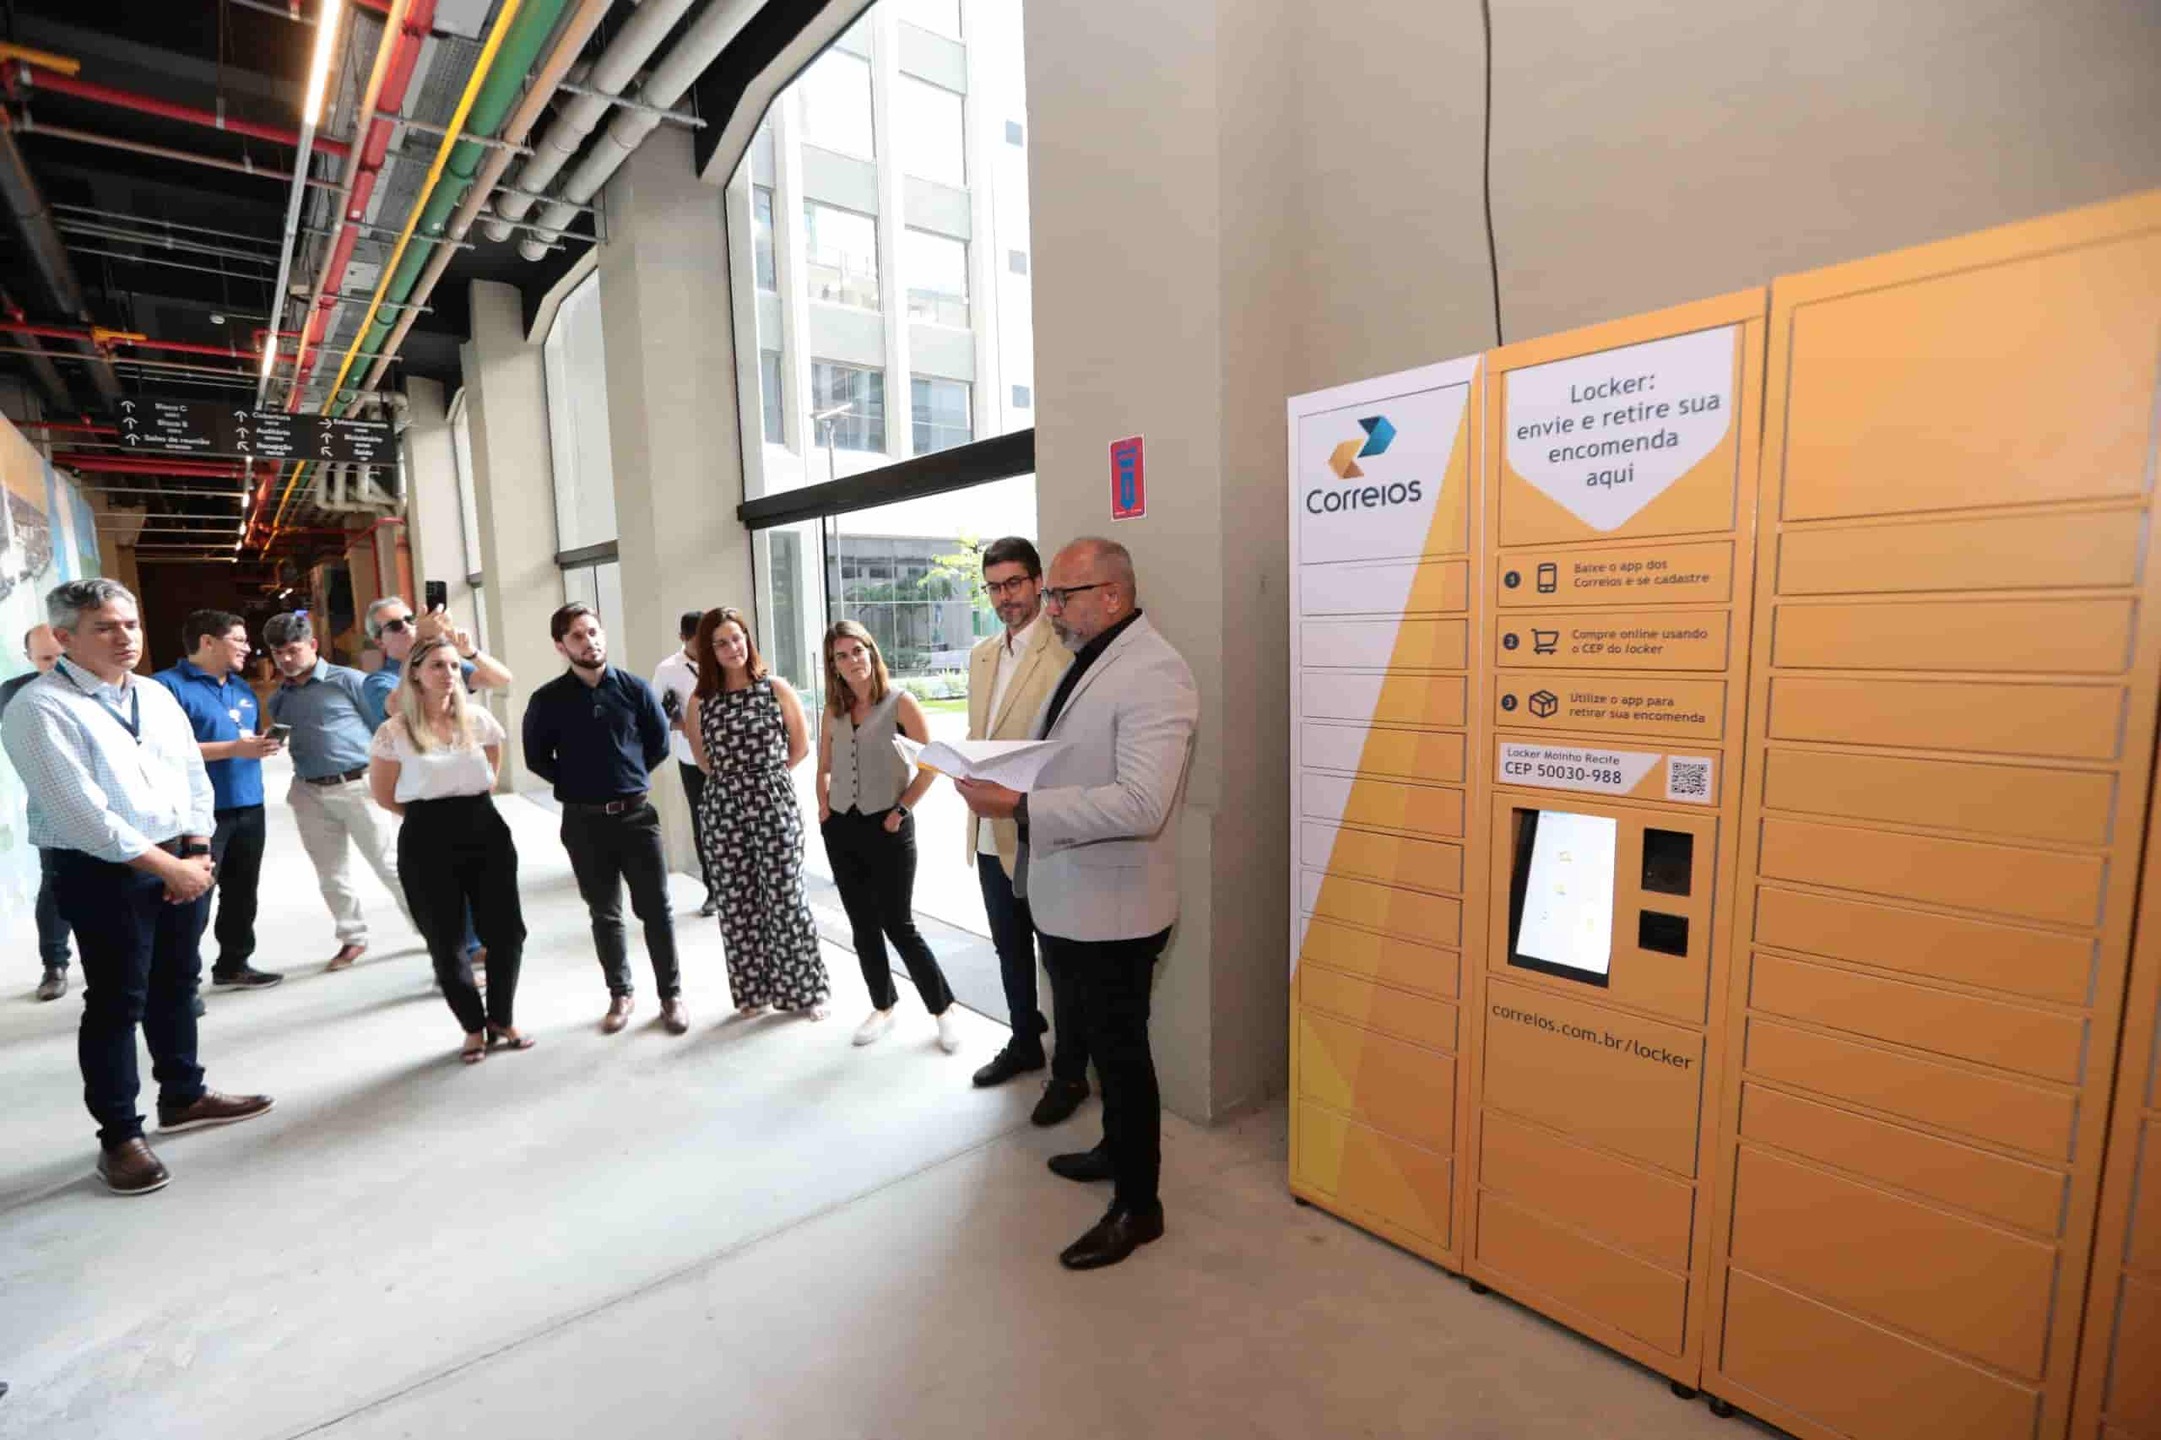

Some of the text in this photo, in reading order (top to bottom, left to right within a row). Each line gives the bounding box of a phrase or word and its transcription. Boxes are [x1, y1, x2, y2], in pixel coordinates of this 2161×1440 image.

[1571, 373, 1656, 404] Locker:
[1517, 392, 1720, 440] envie e retire sua
[1548, 429, 1678, 463] encomenda
[1586, 463, 1634, 489] aqui
[1306, 479, 1422, 514] Correios
[1574, 559, 1668, 574] Baixe o app dos
[1574, 573, 1710, 588] Correios e se cadastre
[1572, 628, 1708, 640] Compre online usando
[1571, 643, 1664, 655] o CEP do locker
[1570, 693, 1674, 709] Utilize o app para
[1569, 708, 1706, 724] retirar sua encomenda
[1507, 746, 1620, 765] Locker Moinho Recife
[1505, 761, 1622, 785] CEP 50030-988
[1492, 1004, 1694, 1070] correios.com.br/locker
